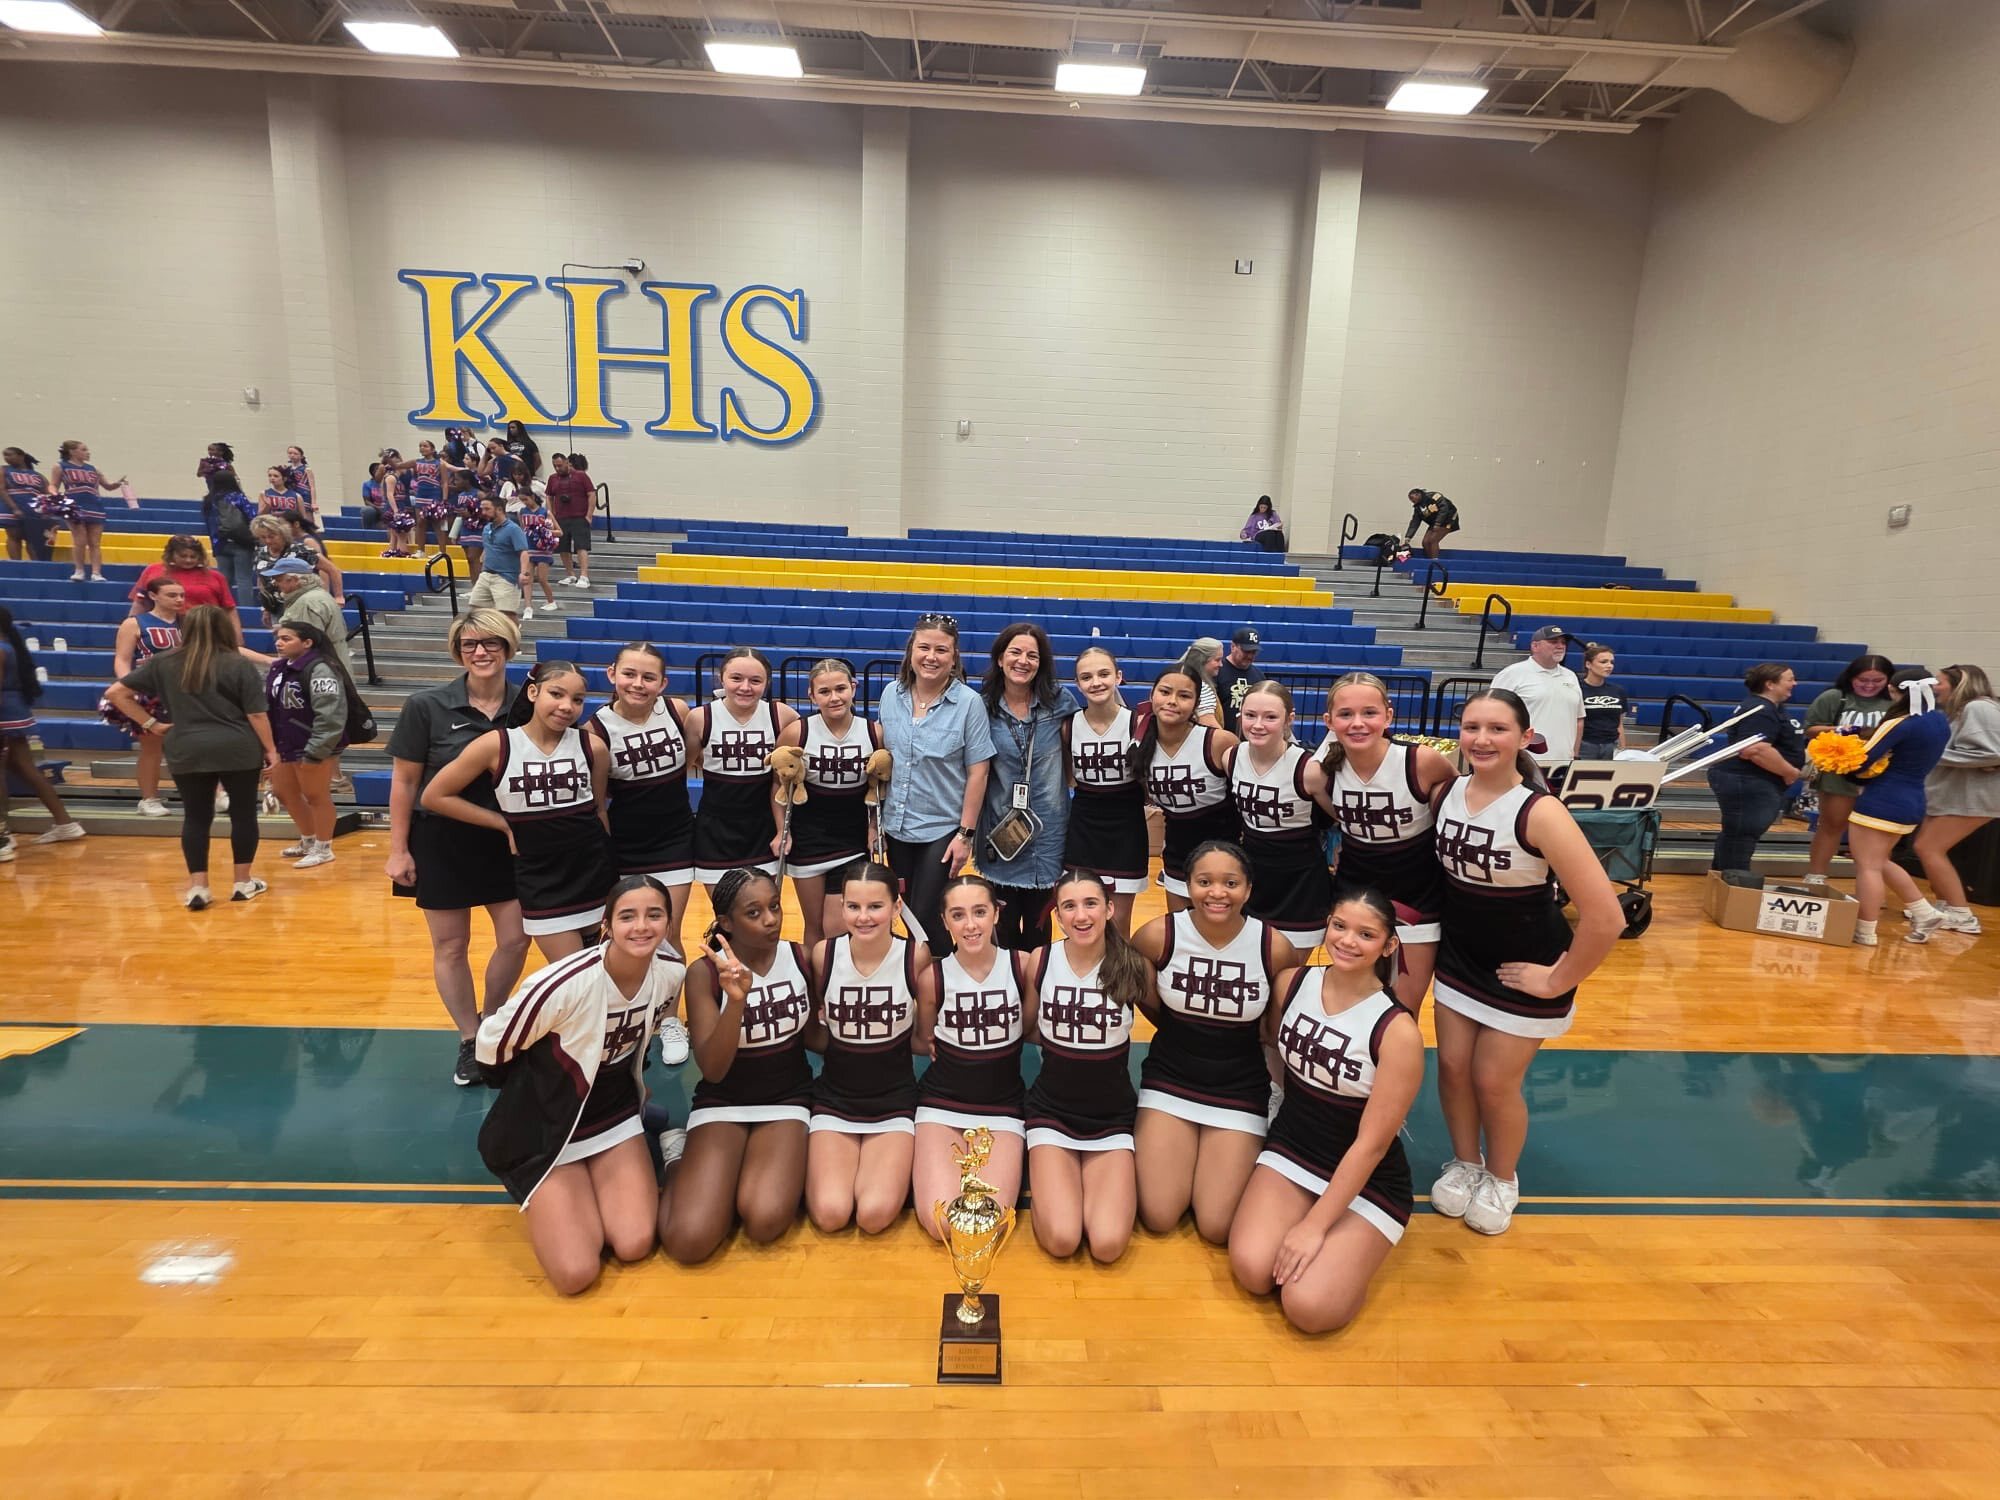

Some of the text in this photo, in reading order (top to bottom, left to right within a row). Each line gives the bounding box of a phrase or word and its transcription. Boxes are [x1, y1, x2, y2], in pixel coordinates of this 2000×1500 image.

[398, 269, 820, 446] KHS
[1171, 972, 1260, 1003] KNIGHTS
[828, 1002, 907, 1025] KNIGHTS
[944, 1004, 1020, 1027] KNIGHTS
[1043, 1001, 1122, 1029] KNIGHTS
